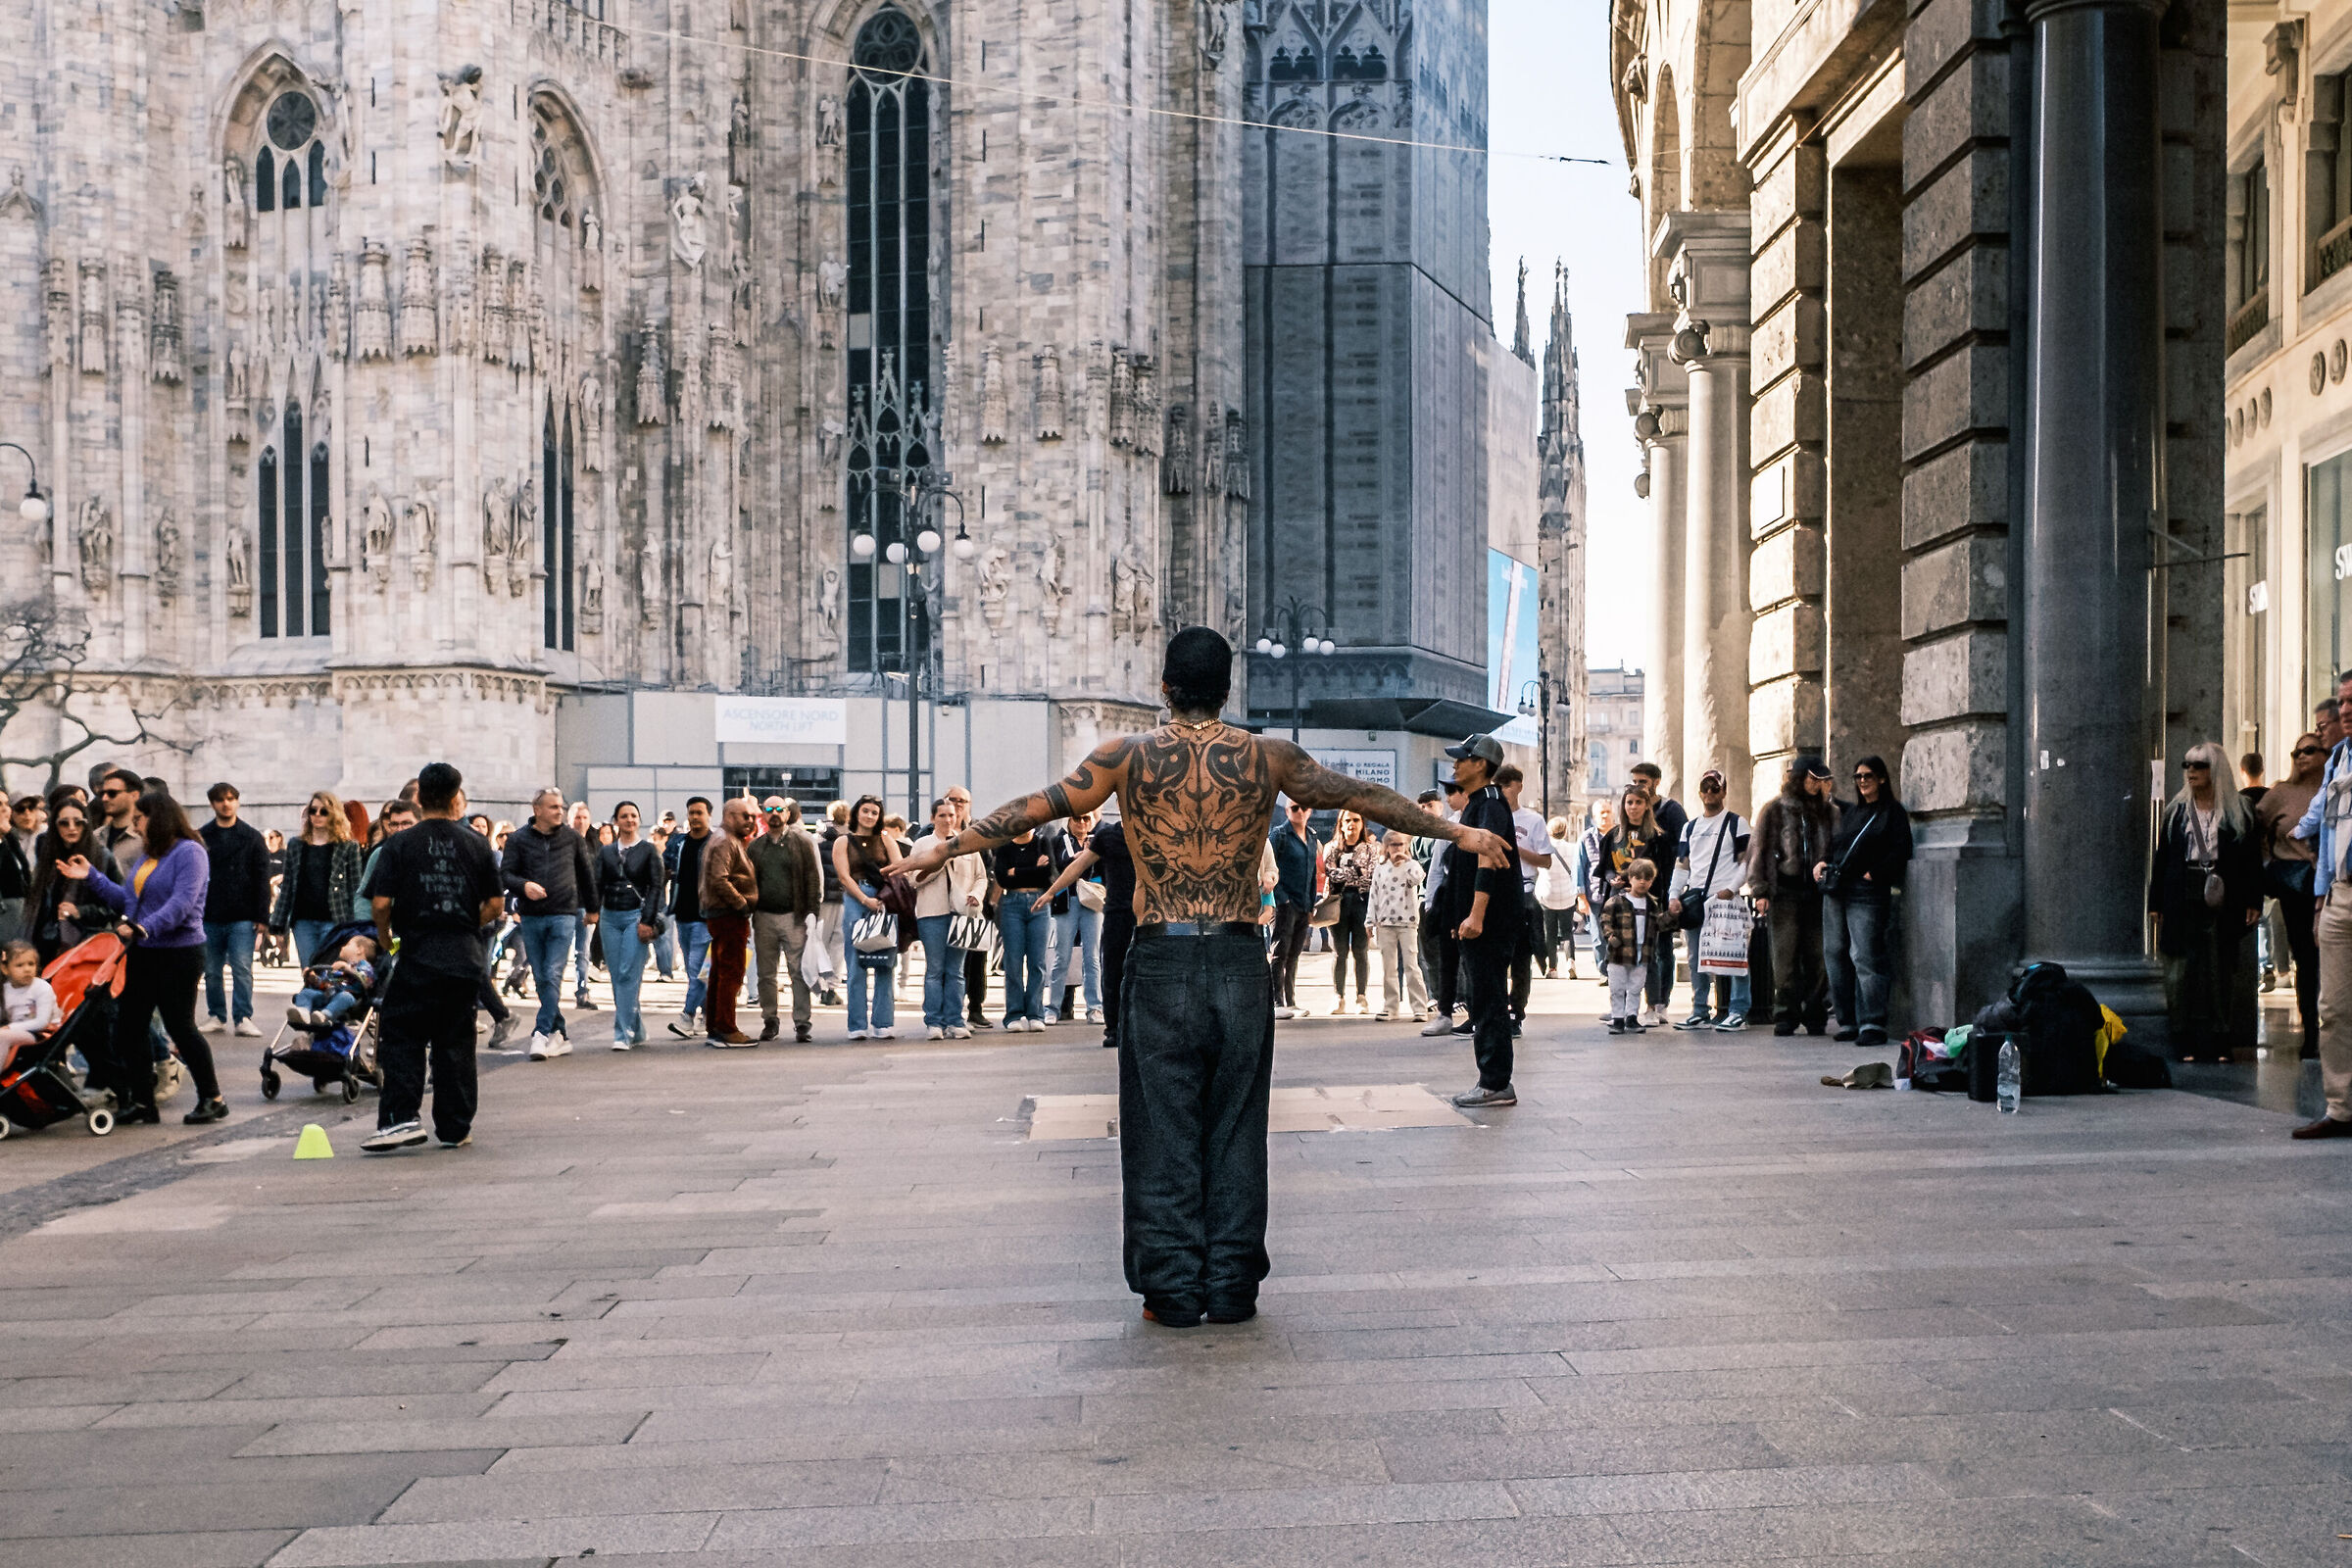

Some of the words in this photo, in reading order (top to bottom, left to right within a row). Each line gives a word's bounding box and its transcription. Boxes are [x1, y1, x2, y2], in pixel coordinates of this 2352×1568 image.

[722, 708, 797, 720] ASCENSORE
[800, 710, 839, 721] NORD
[749, 720, 789, 731] NORTH
[792, 721, 813, 732] LIFT
